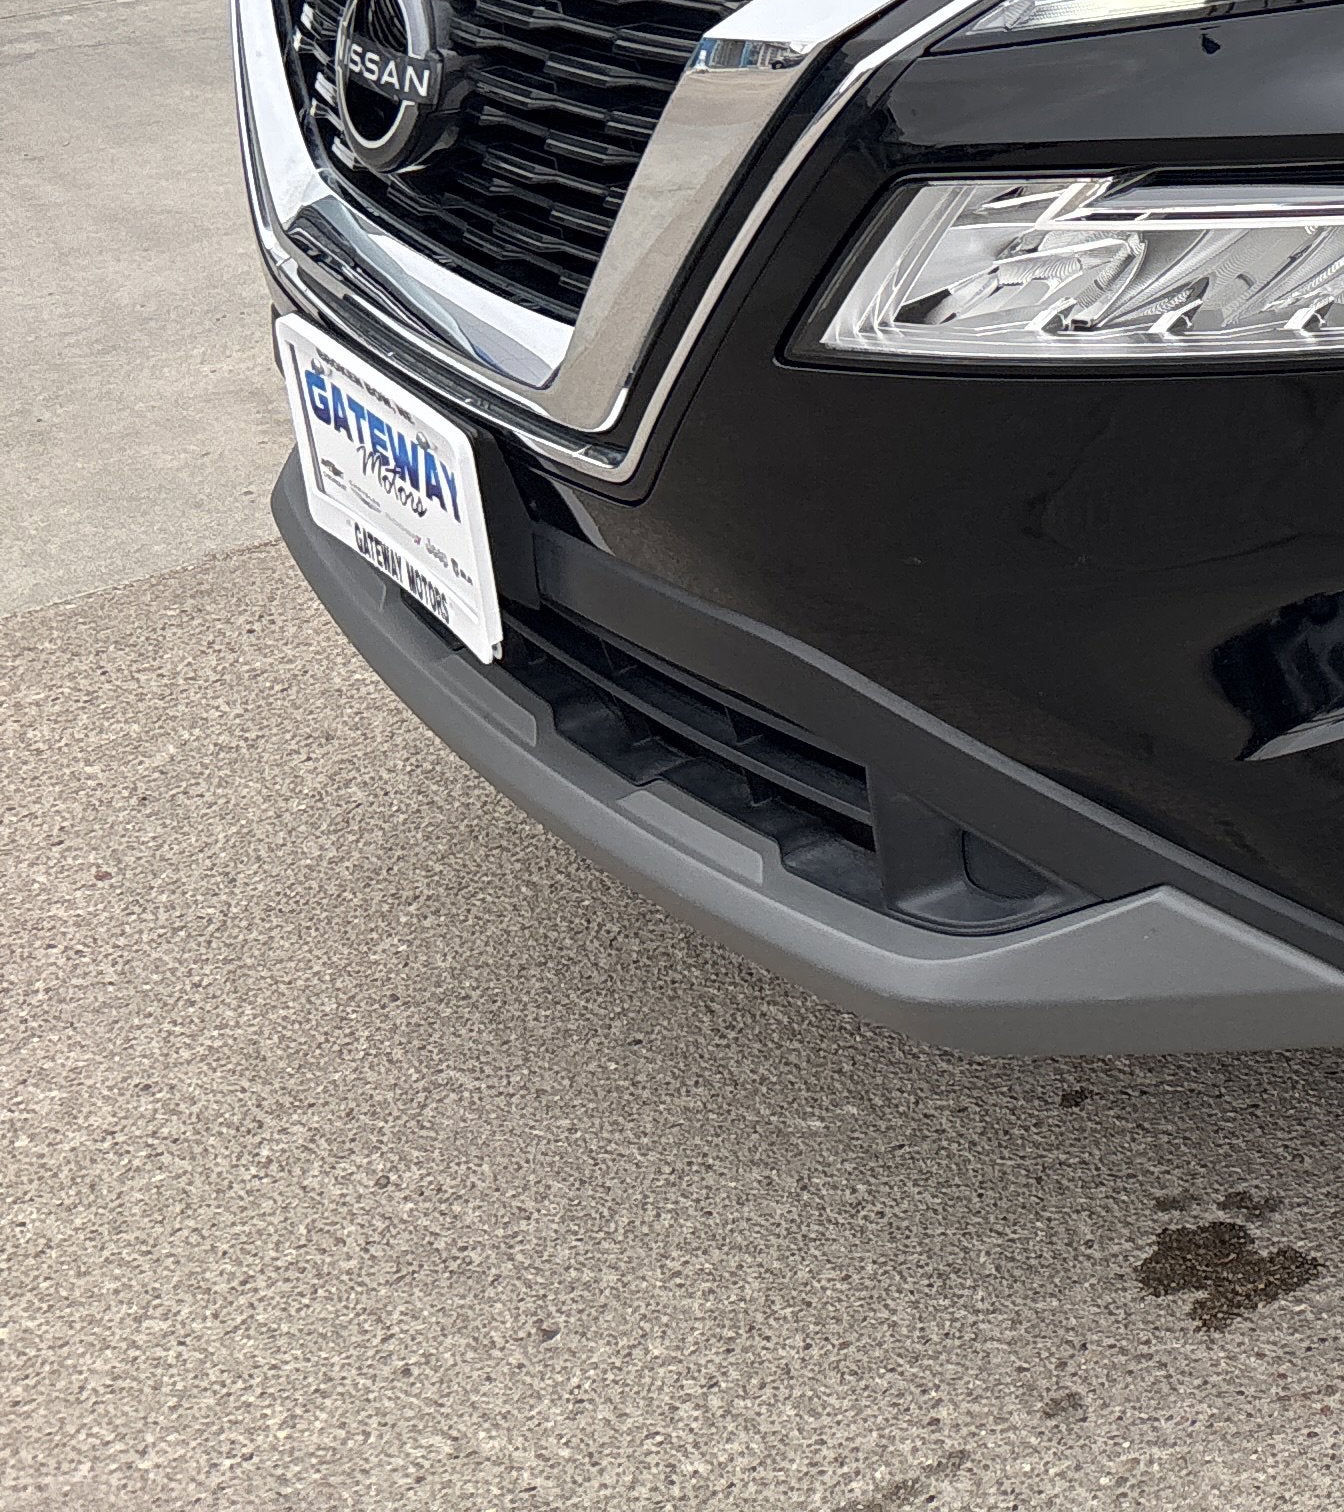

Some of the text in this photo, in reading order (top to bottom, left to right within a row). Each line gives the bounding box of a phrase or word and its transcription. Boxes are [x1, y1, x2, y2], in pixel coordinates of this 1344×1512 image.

[304, 369, 461, 523] GATEWAY
[356, 443, 428, 519] Motors
[354, 522, 402, 585] GATEWAY
[405, 559, 450, 624] MOTORS
